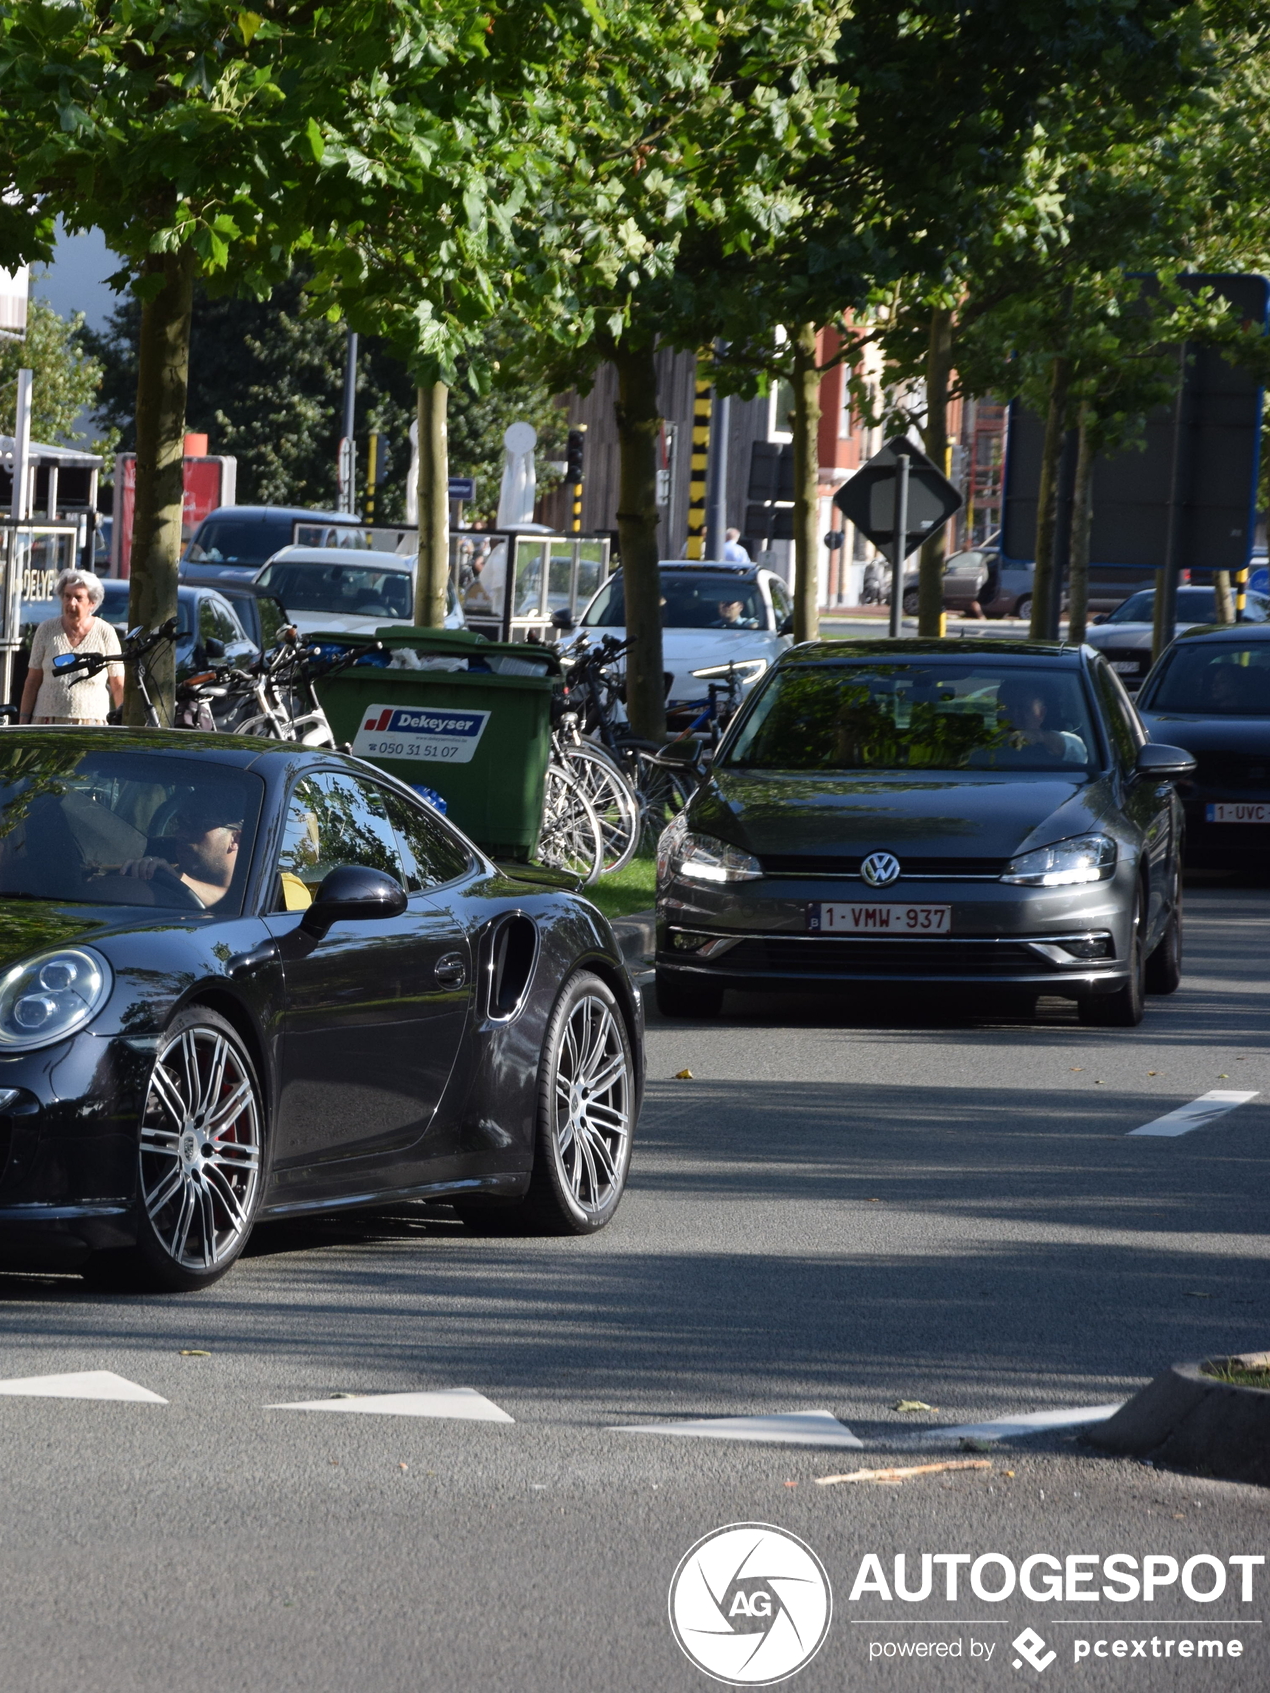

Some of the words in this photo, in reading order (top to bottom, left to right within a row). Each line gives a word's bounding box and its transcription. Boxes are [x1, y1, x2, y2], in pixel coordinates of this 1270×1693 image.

[23, 568, 55, 602] DELYE
[397, 713, 474, 732] Dekeyser
[379, 742, 404, 755] 050
[406, 743, 421, 756] 31
[423, 745, 438, 757] 51
[441, 746, 459, 758] 07
